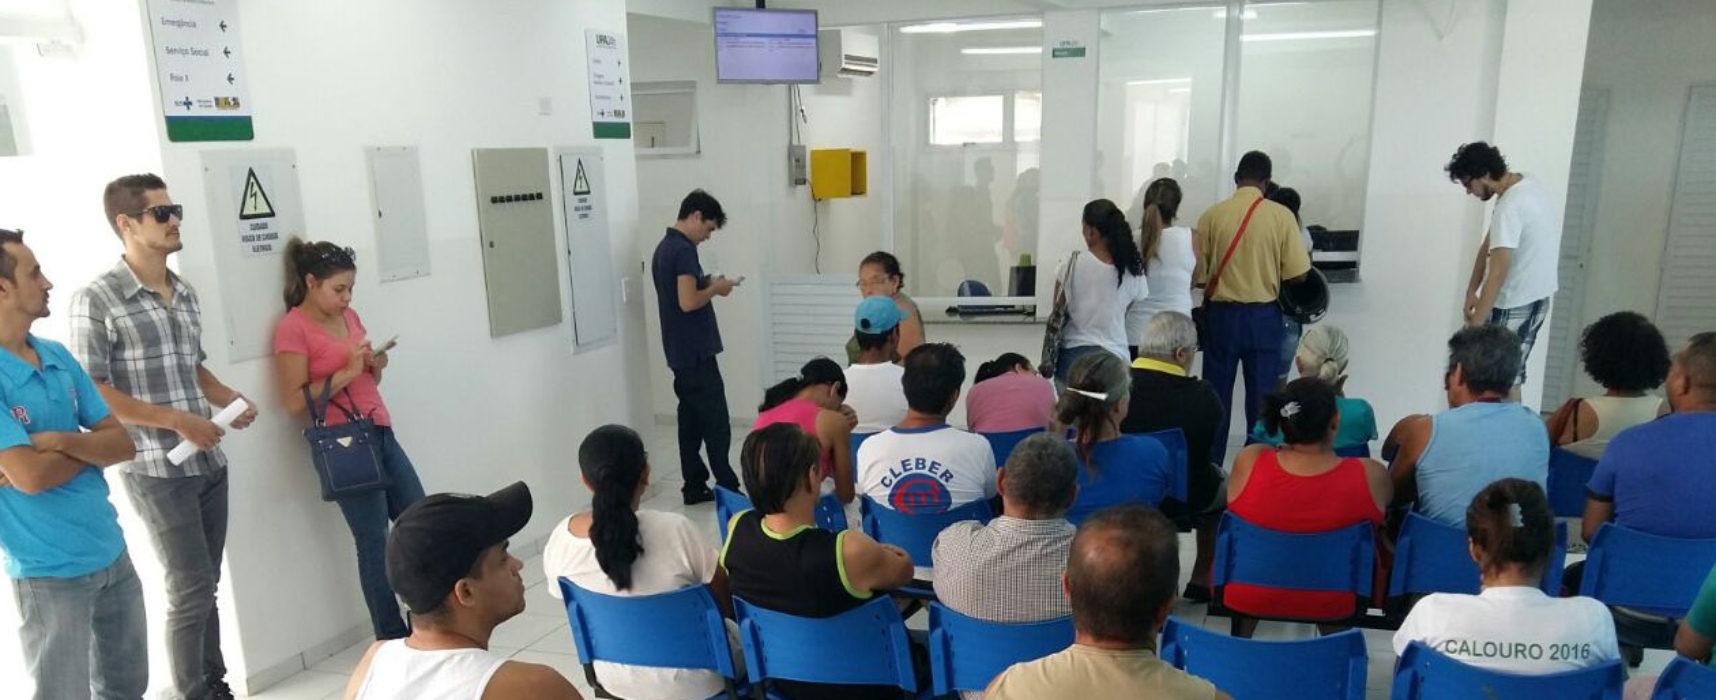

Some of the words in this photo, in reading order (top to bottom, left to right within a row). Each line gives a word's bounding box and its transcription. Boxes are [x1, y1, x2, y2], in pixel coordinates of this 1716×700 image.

[881, 457, 954, 488] CLEBER
[1445, 639, 1543, 660] CALOURO
[1550, 643, 1591, 660] 2016
